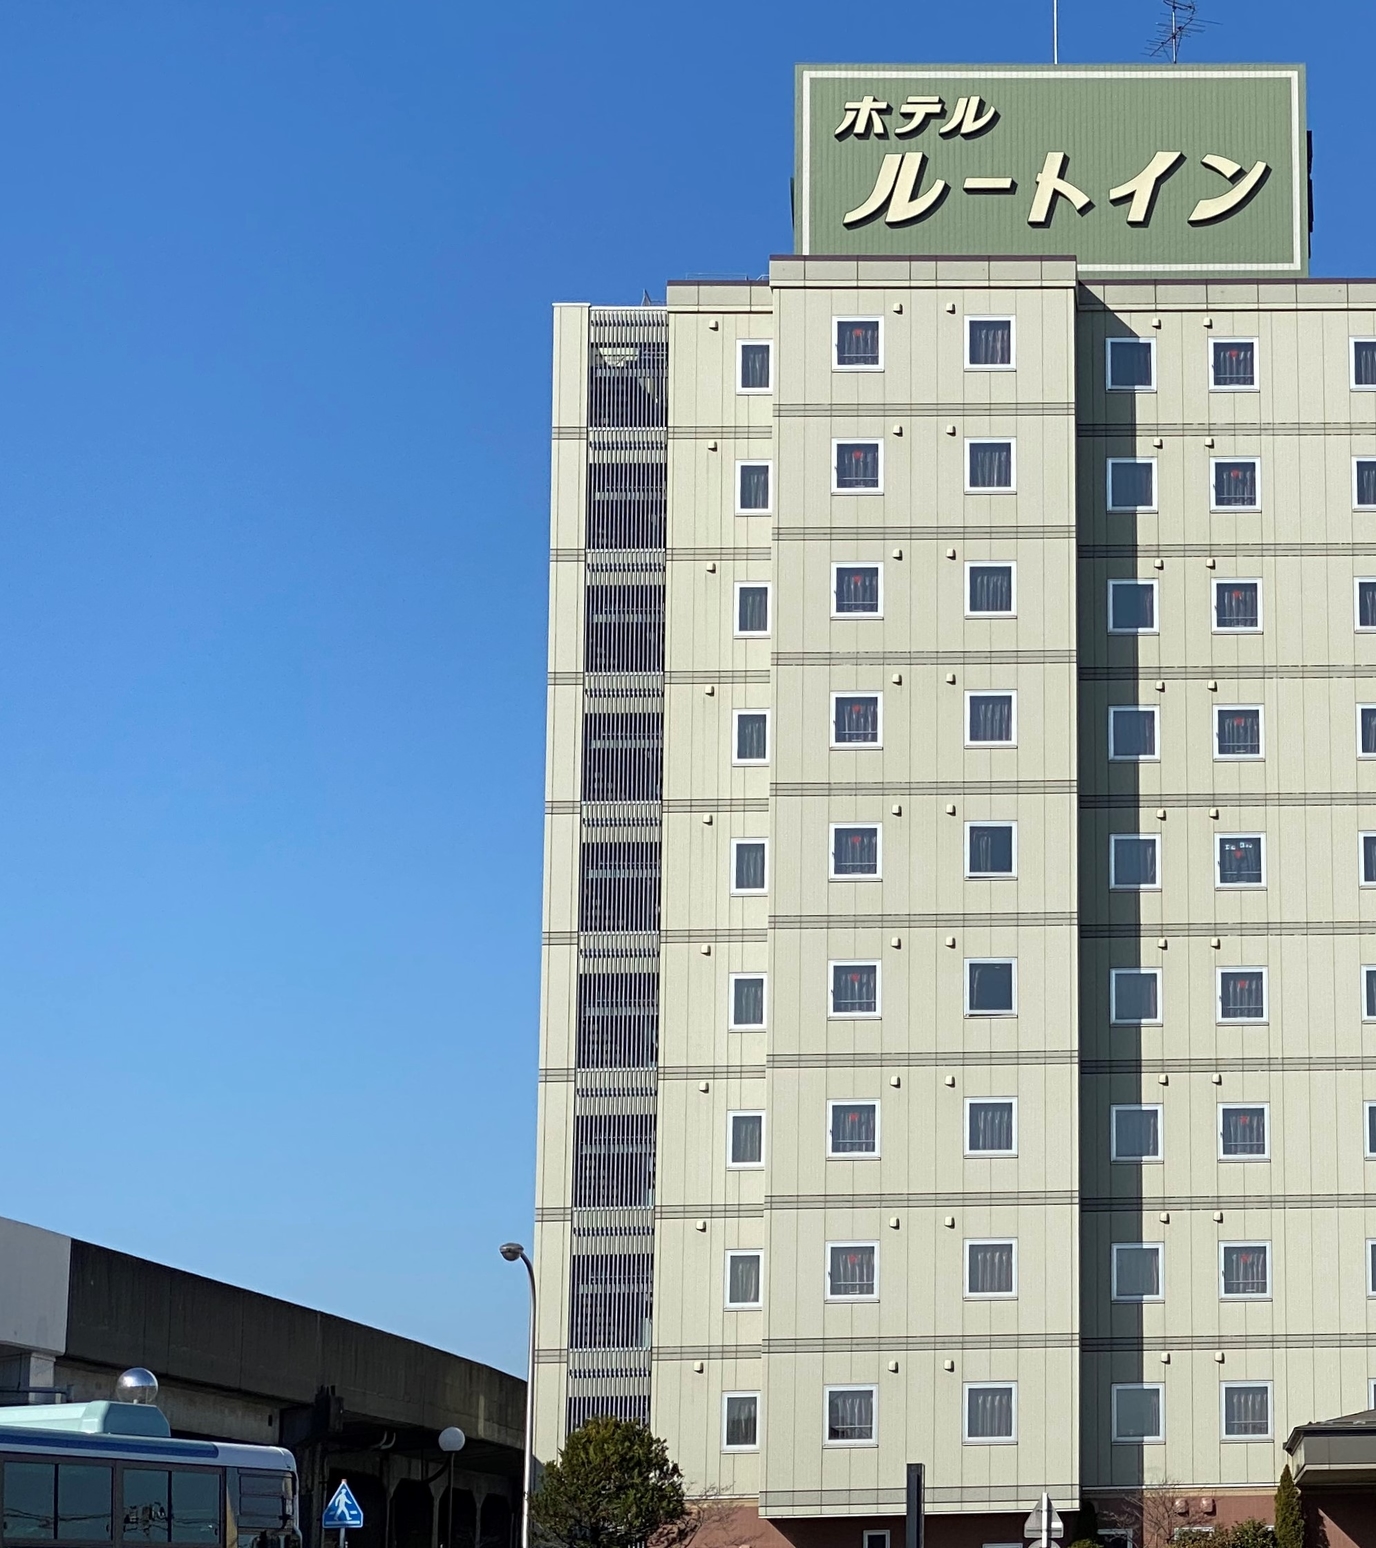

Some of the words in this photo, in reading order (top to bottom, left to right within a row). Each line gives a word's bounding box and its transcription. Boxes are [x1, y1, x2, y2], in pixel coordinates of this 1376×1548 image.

[834, 95, 1000, 141] ホテル
[842, 150, 1271, 230] ルートイン
